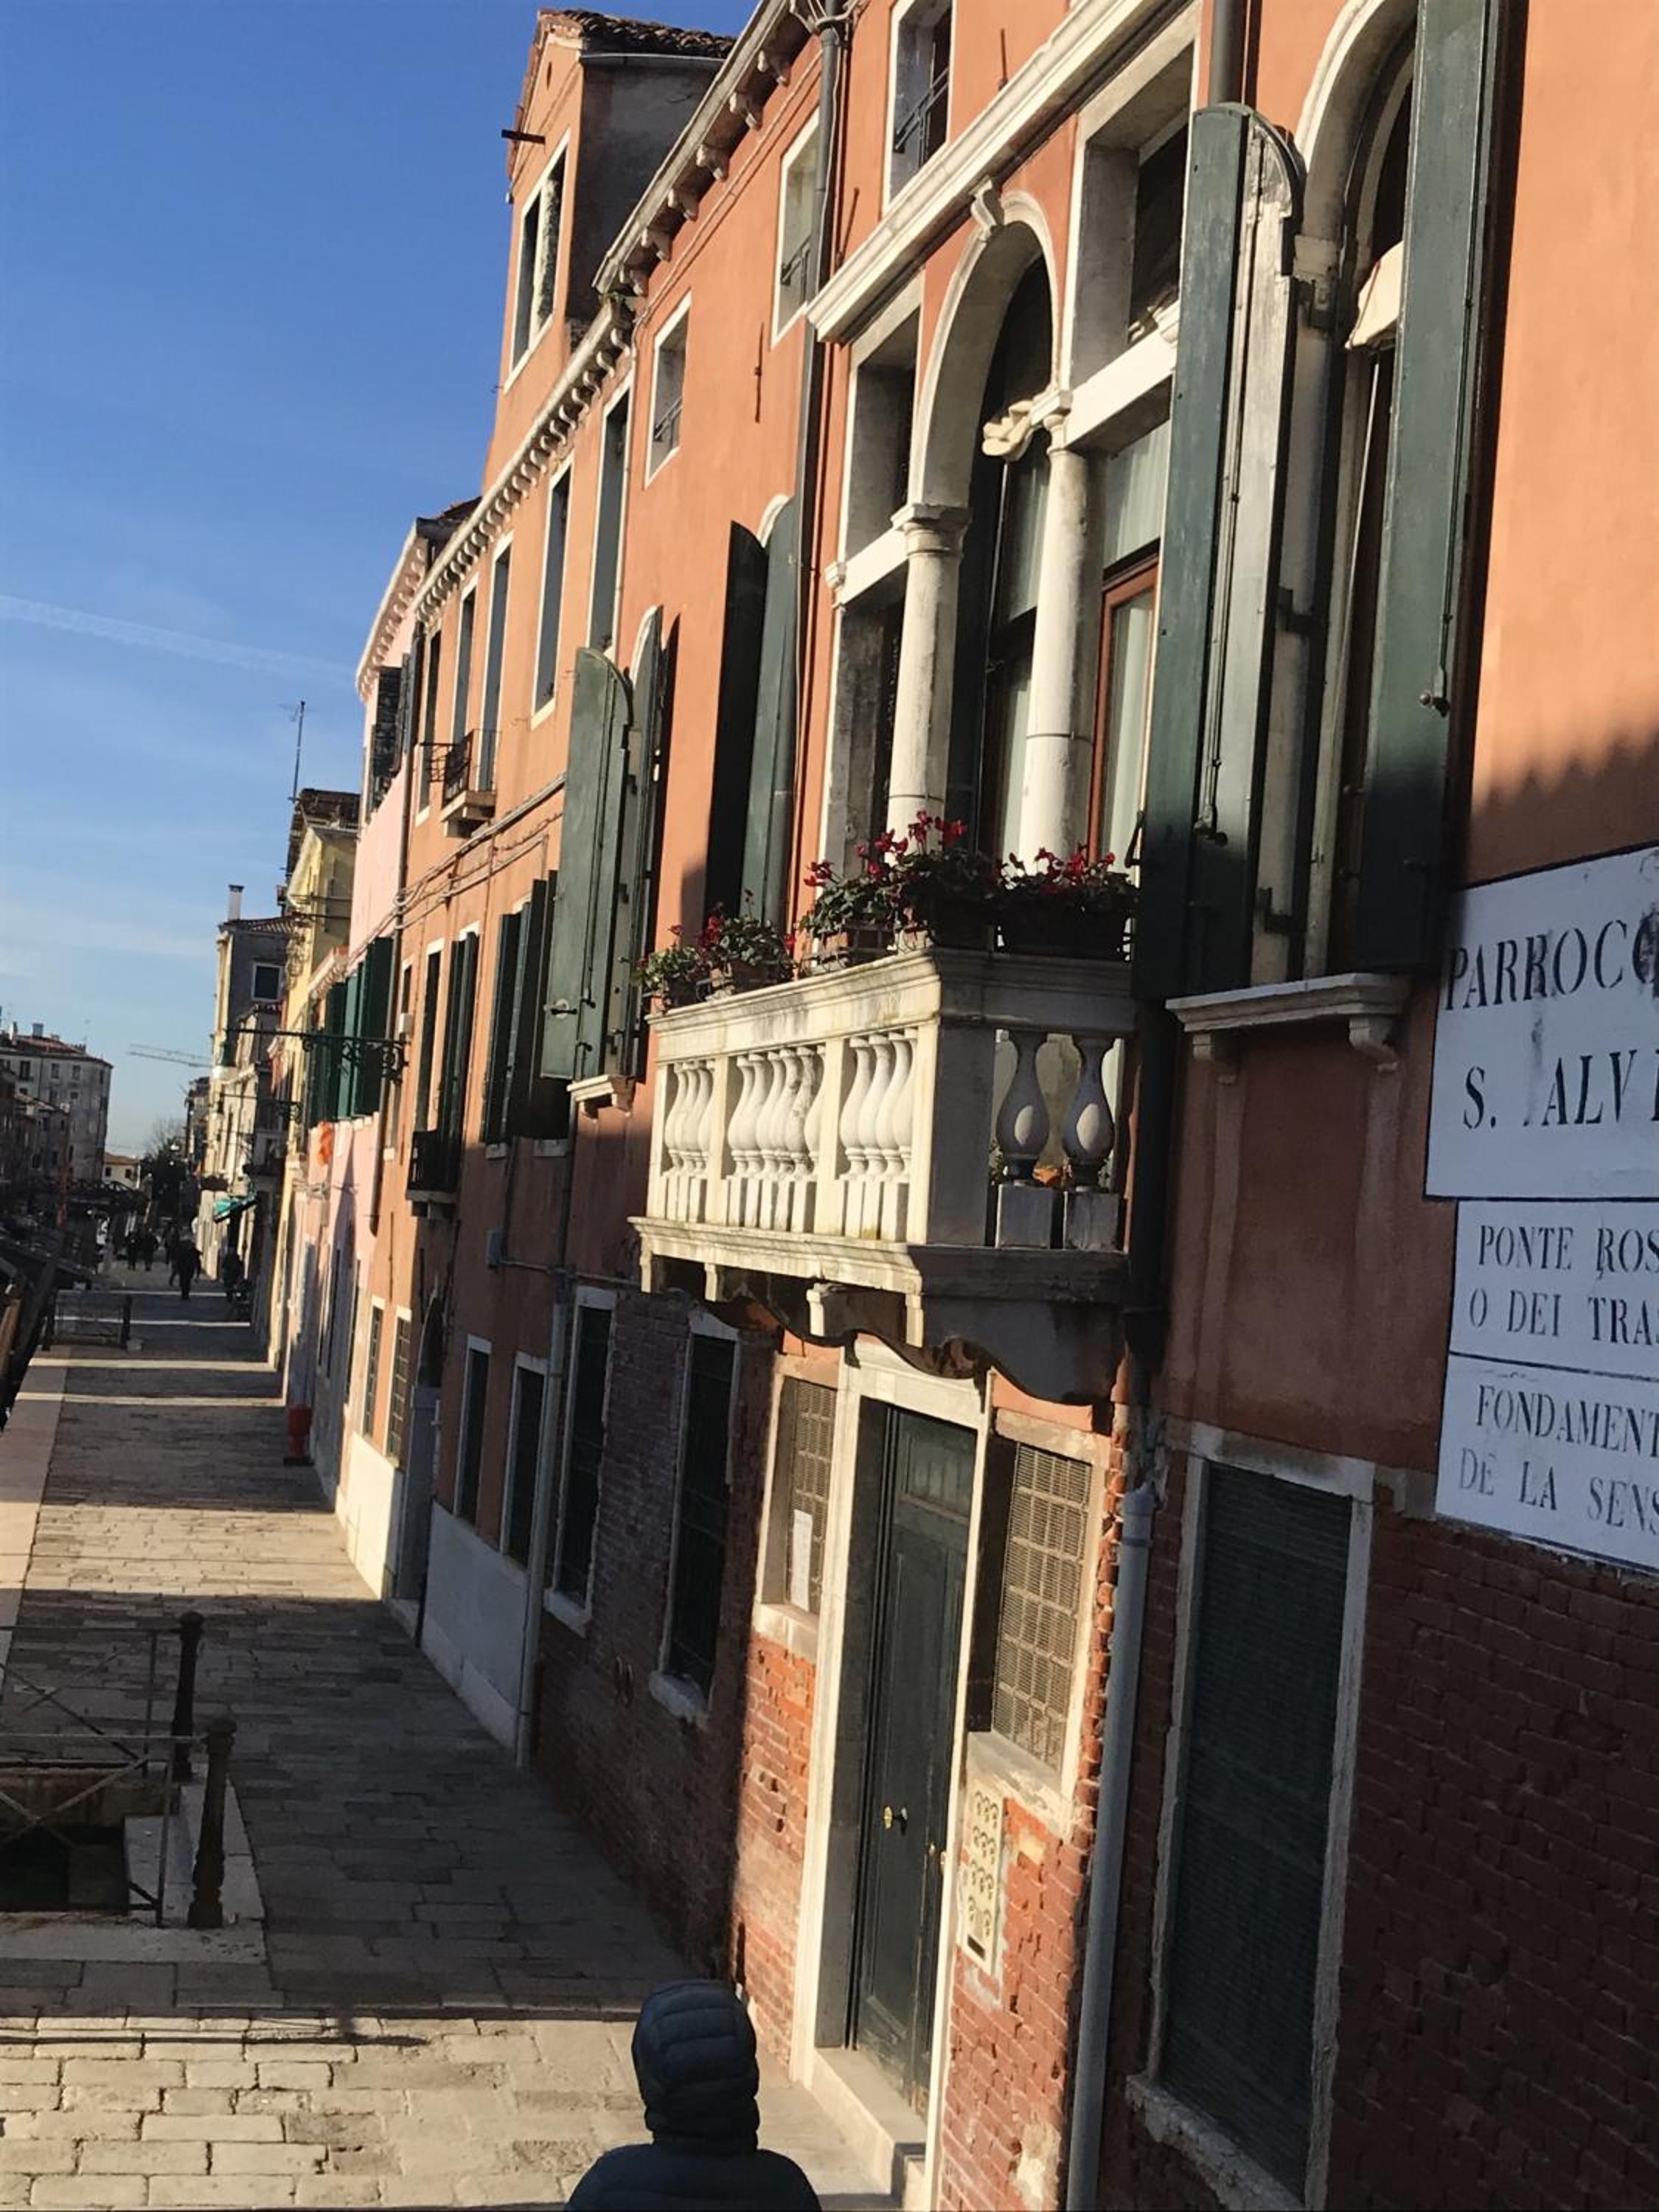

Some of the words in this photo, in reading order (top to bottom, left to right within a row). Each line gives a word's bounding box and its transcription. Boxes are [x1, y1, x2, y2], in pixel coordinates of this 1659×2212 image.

[1463, 1065, 1496, 1129] S.
[1478, 1224, 1573, 1271] PONTE
[1470, 1287, 1487, 1328] O
[1506, 1289, 1561, 1338] DEI
[1587, 1297, 1659, 1346] TRA
[1459, 1447, 1495, 1497] DE
[1518, 1461, 1557, 1511] LA
